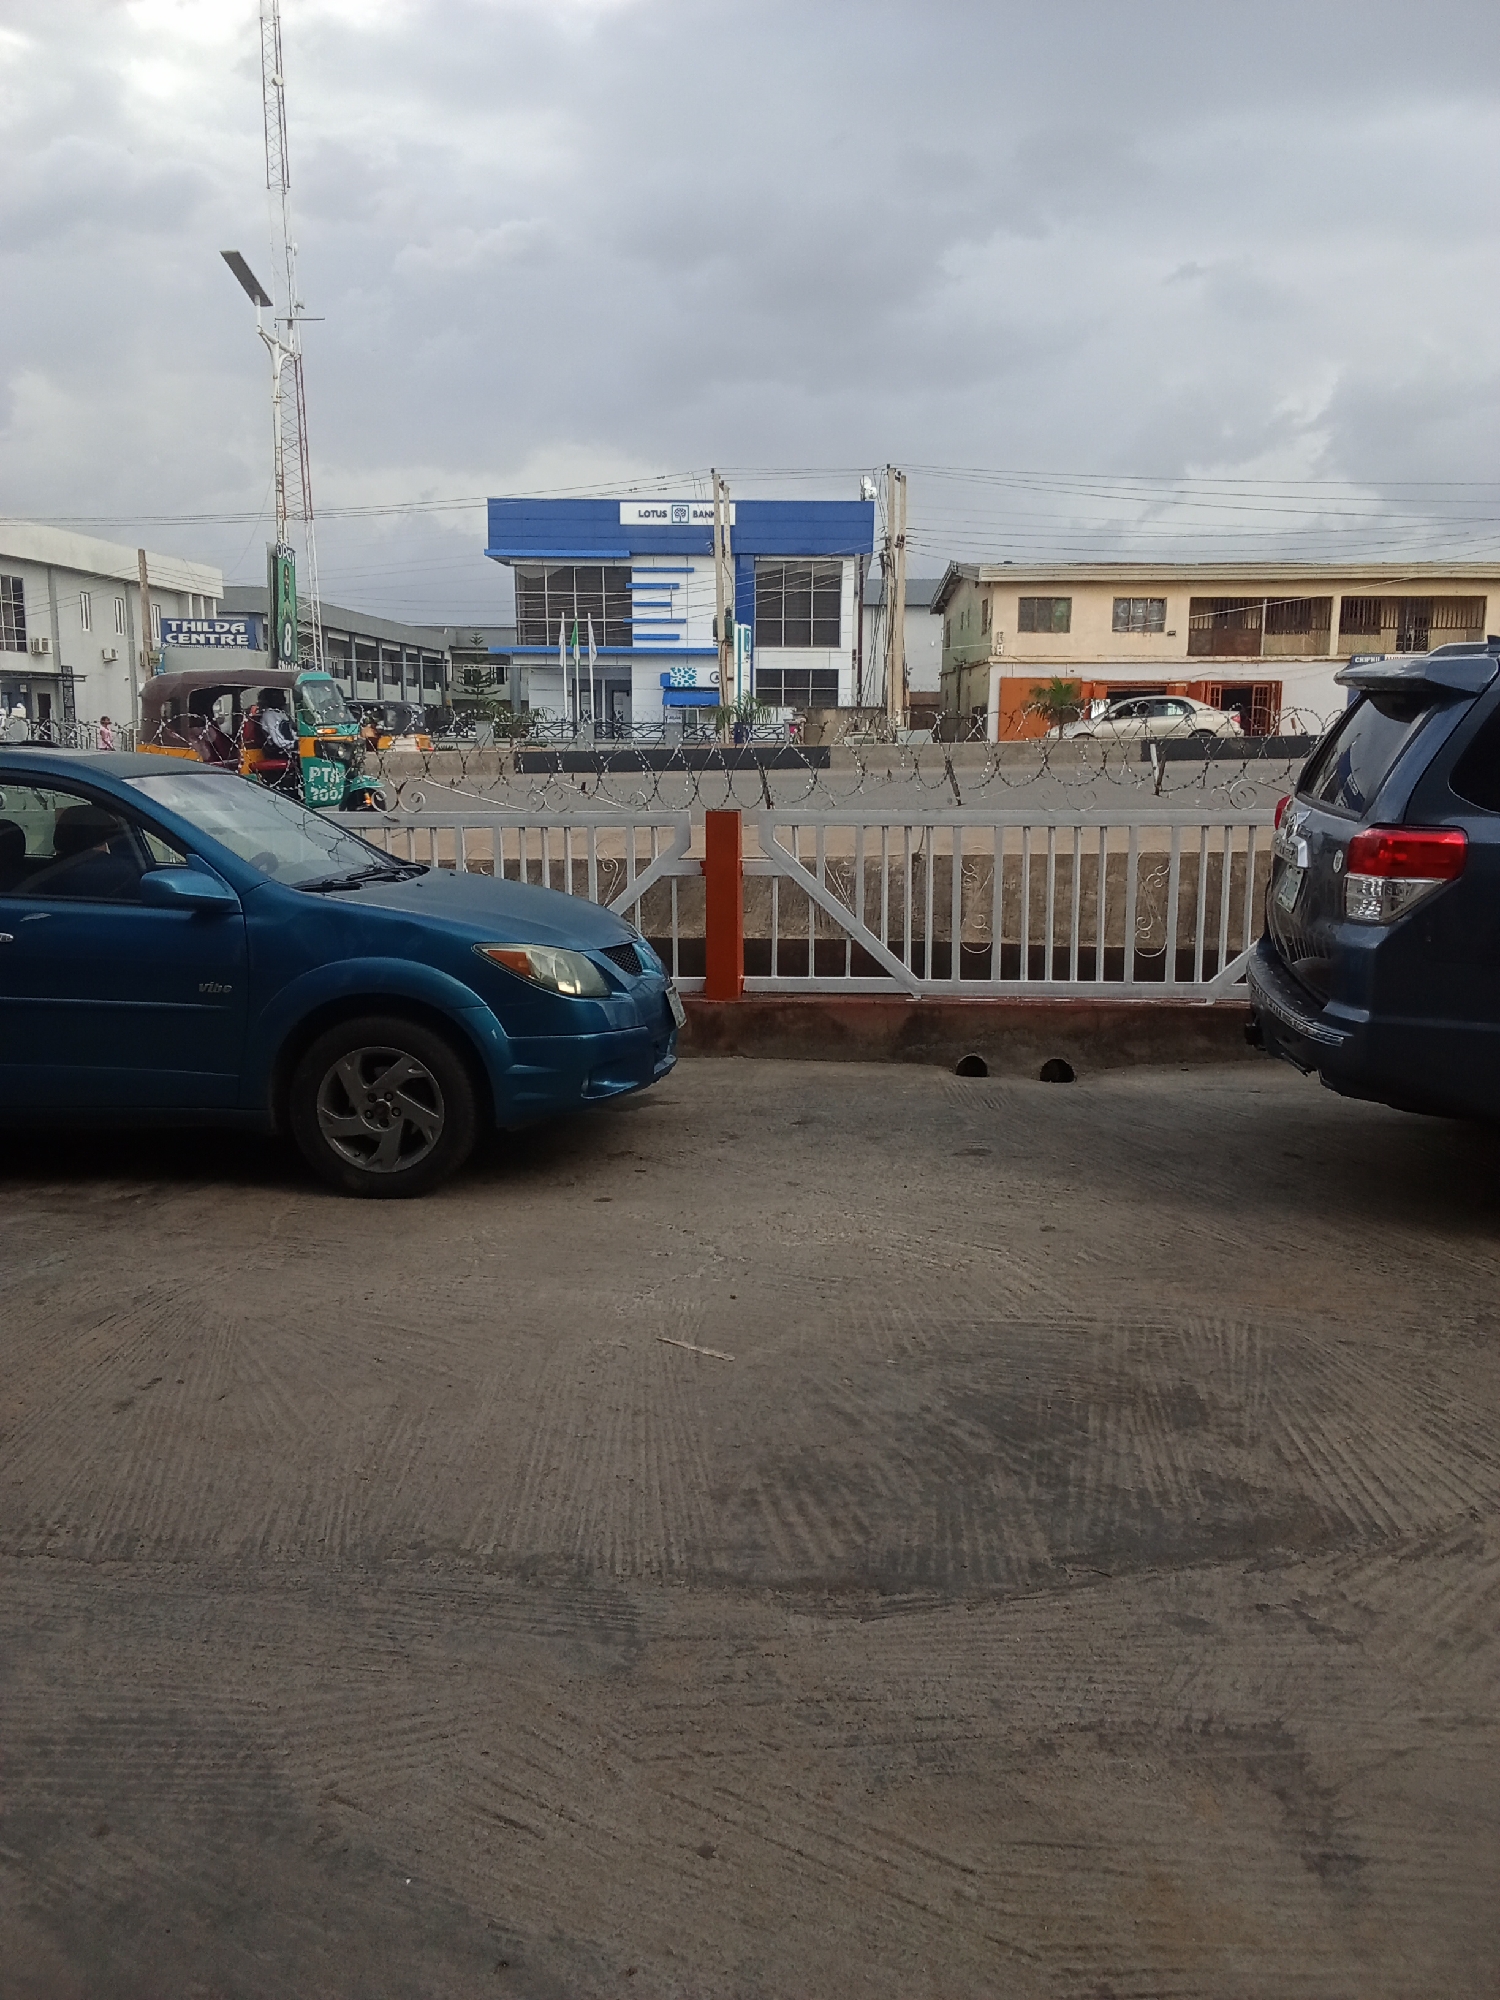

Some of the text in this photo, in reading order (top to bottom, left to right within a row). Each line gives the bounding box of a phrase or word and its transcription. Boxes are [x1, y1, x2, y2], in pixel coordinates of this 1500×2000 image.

[638, 509, 715, 518] LOTUS BANK
[167, 620, 246, 634] THILDA
[165, 633, 249, 646] CENTRE
